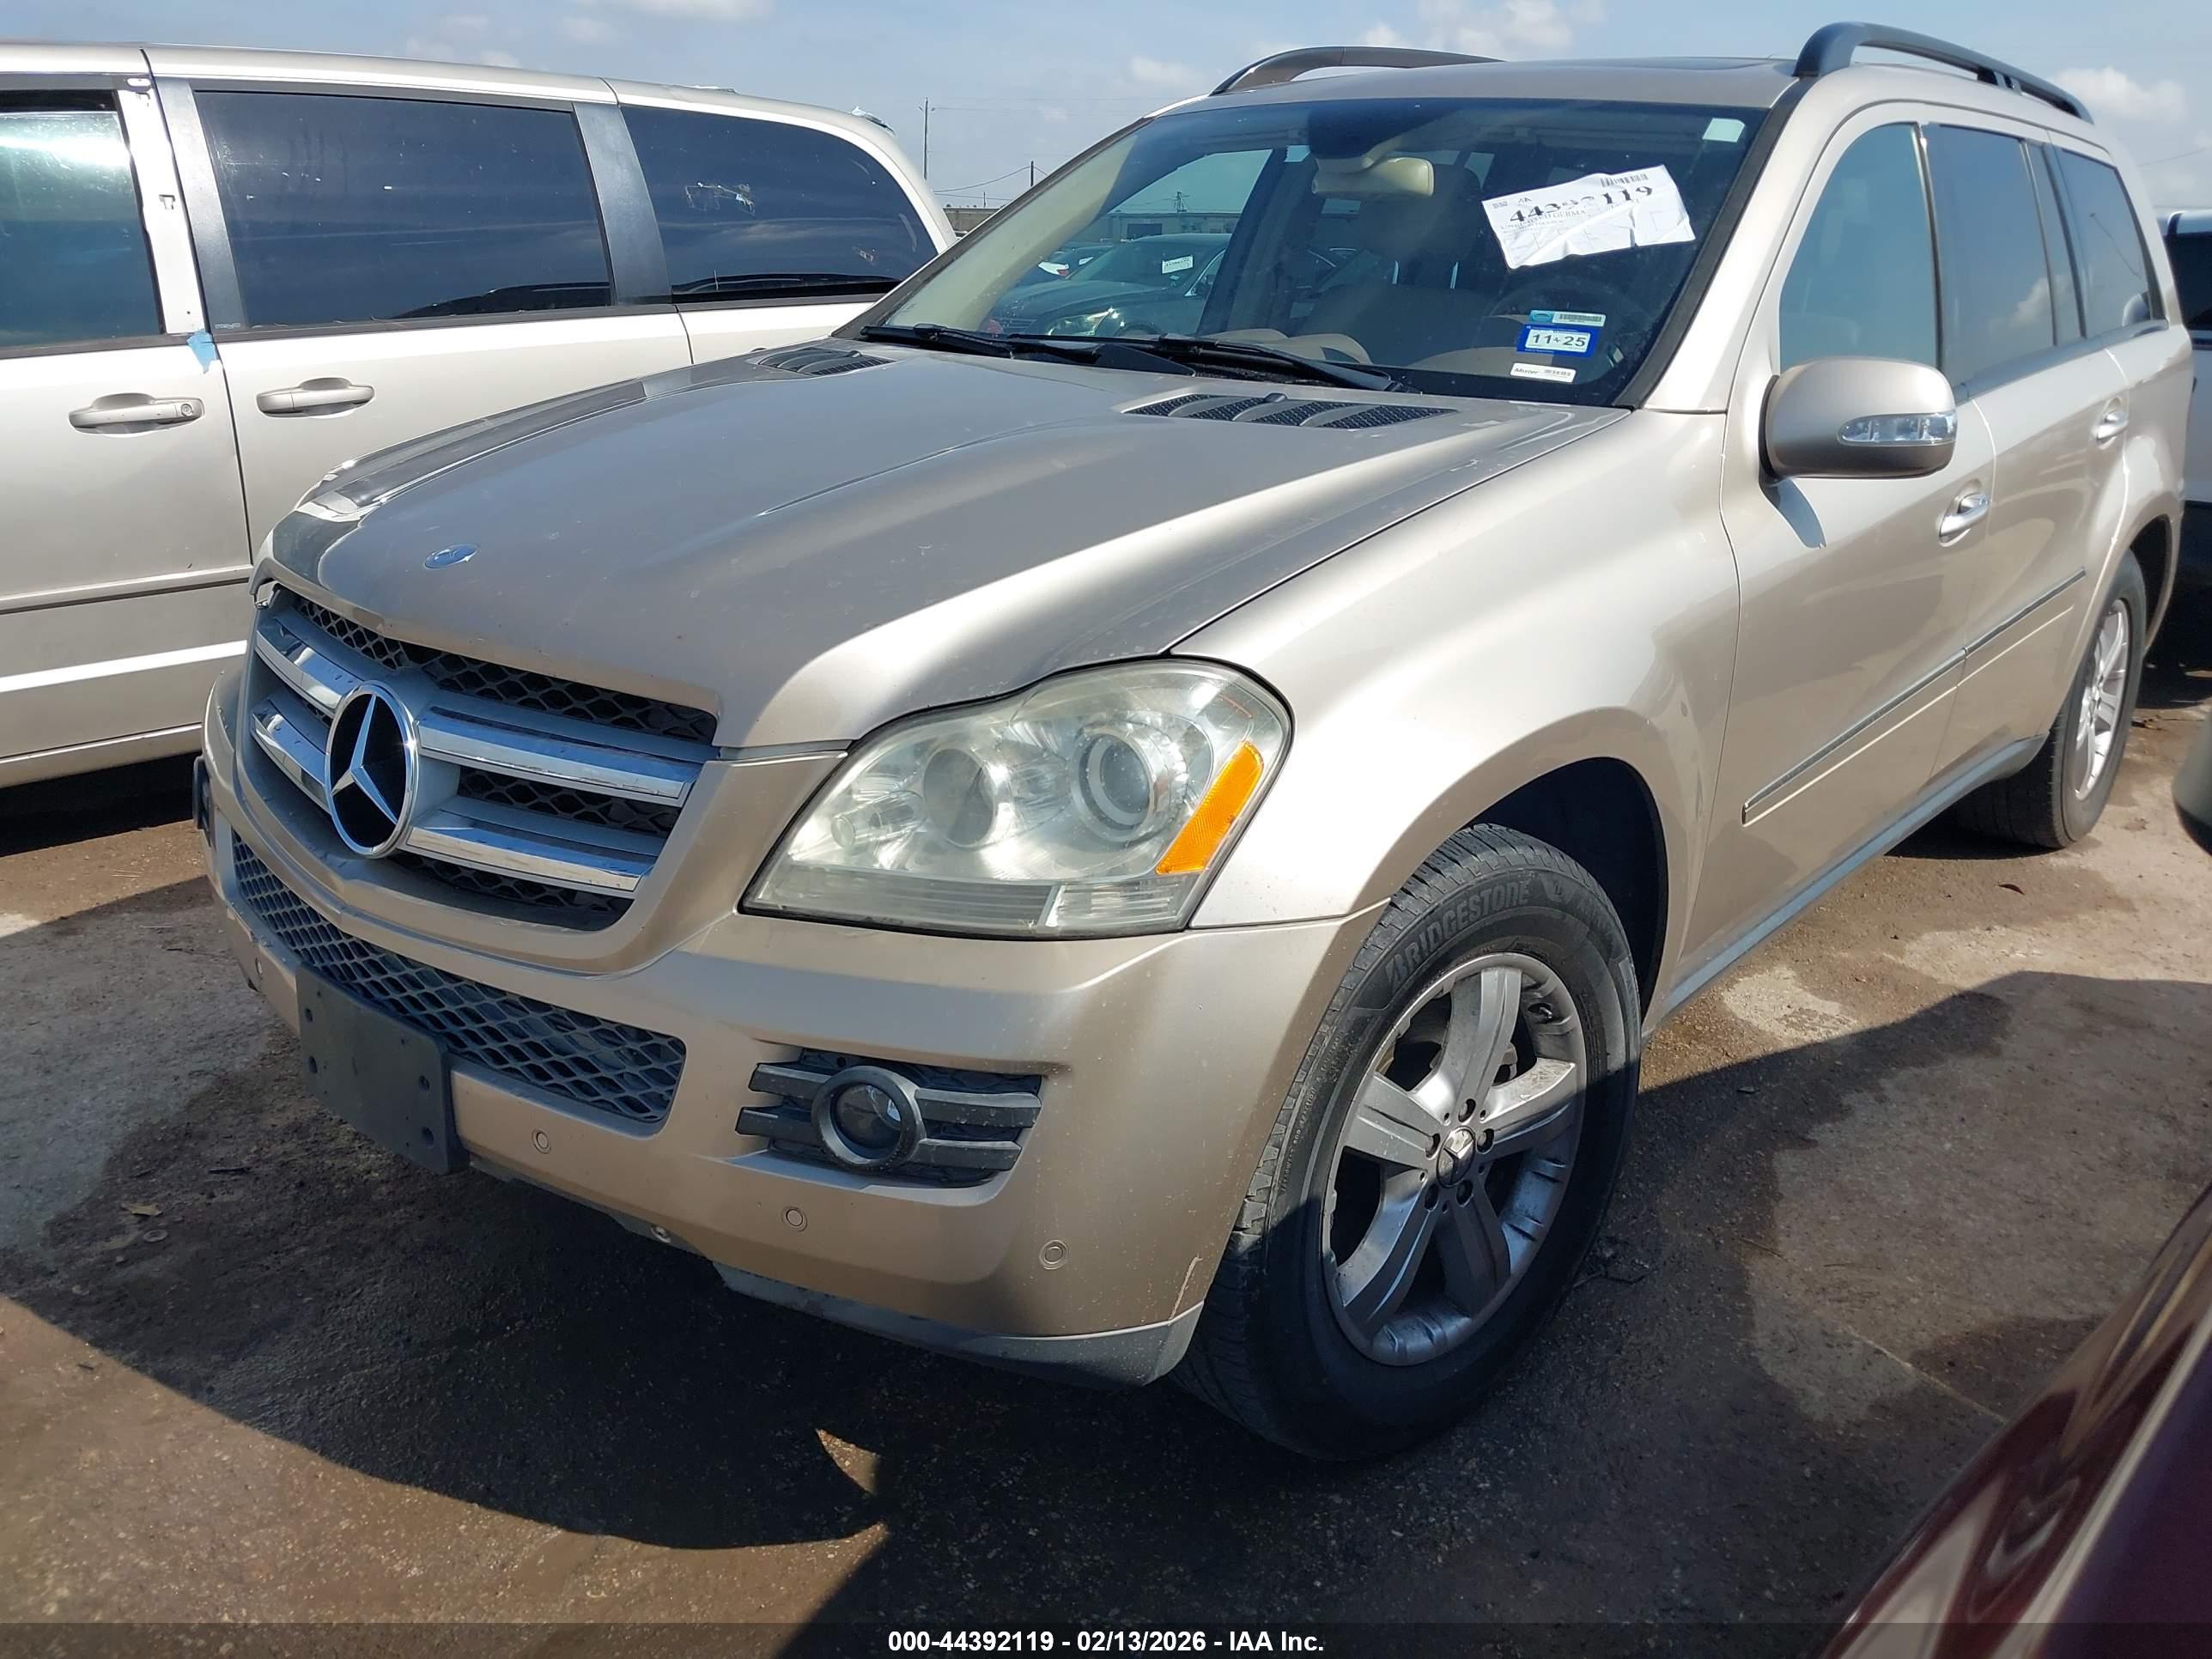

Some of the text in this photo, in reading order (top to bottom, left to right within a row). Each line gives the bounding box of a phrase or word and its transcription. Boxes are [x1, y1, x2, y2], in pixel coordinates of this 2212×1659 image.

[1532, 333, 1587, 348] 11 25
[1384, 879, 1530, 996] BRIDGESTONE
